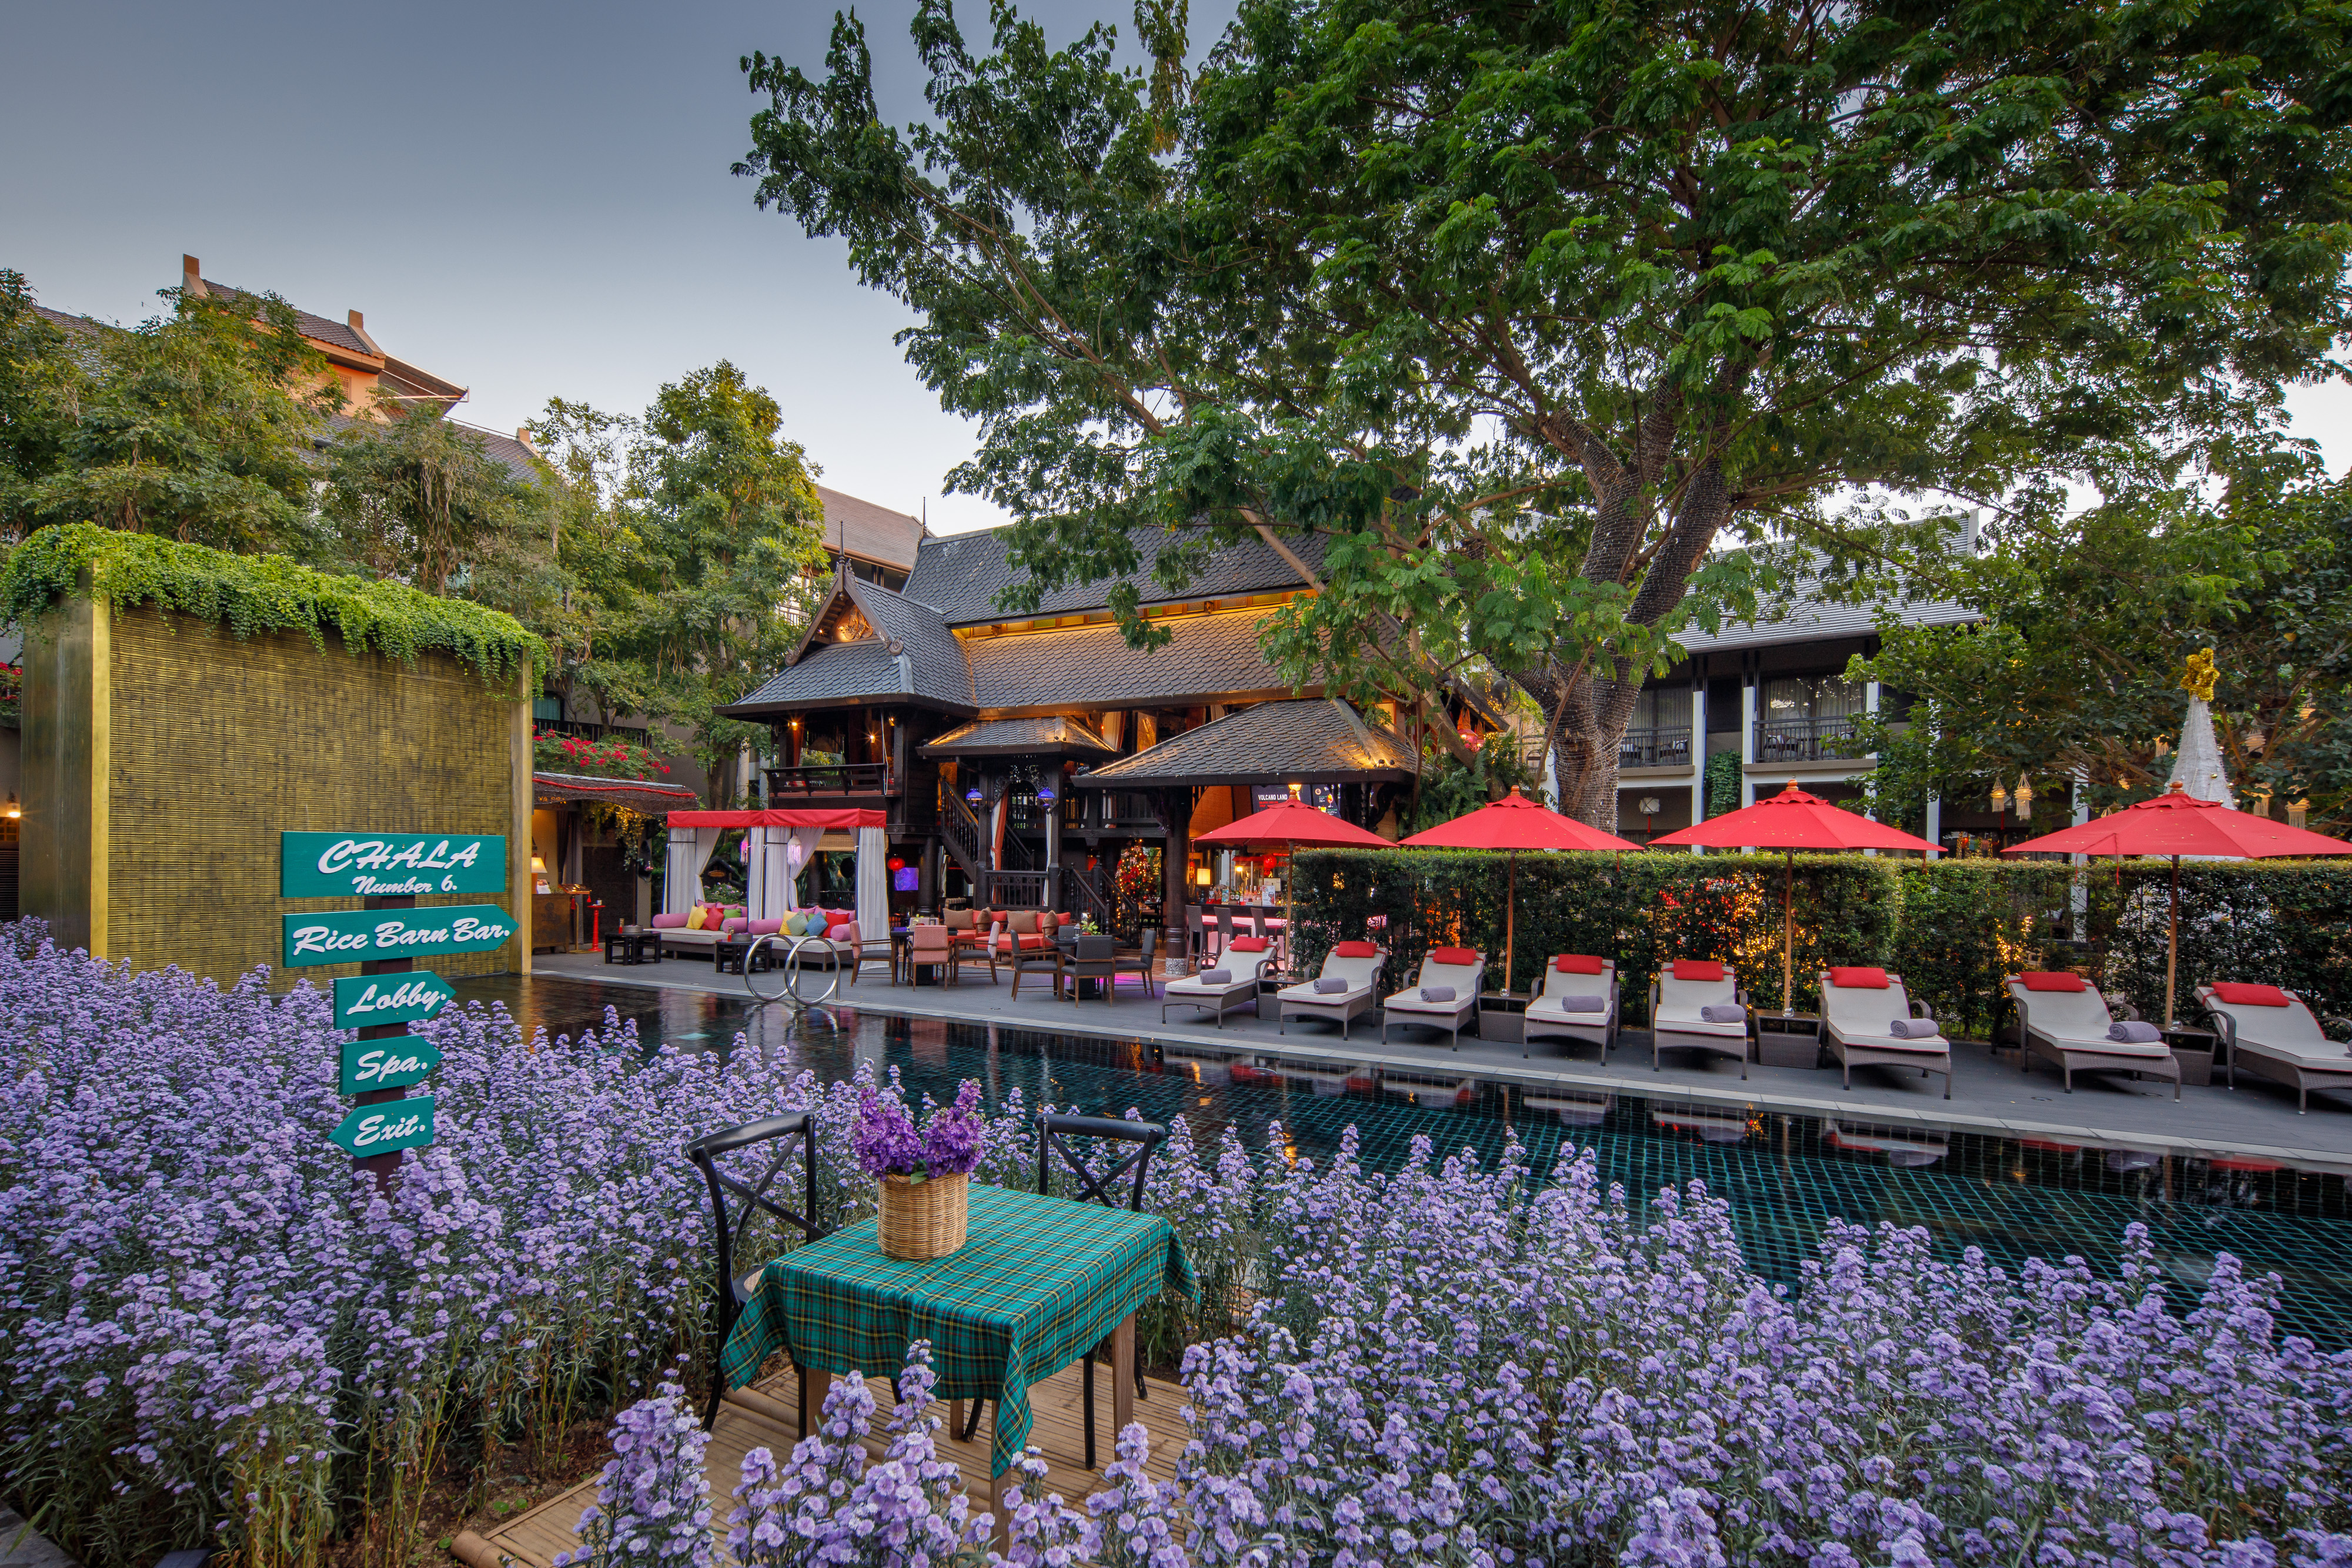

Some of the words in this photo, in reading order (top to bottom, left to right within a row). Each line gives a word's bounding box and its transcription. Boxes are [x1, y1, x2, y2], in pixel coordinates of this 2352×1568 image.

[318, 840, 481, 874] CHALA
[352, 875, 433, 895] Number
[293, 926, 369, 957] Rice
[375, 921, 449, 948] Barn
[452, 917, 510, 942] Bar.
[346, 981, 447, 1015] Lobby.
[355, 1050, 428, 1083] Spa.
[353, 1114, 426, 1147] Exit.
